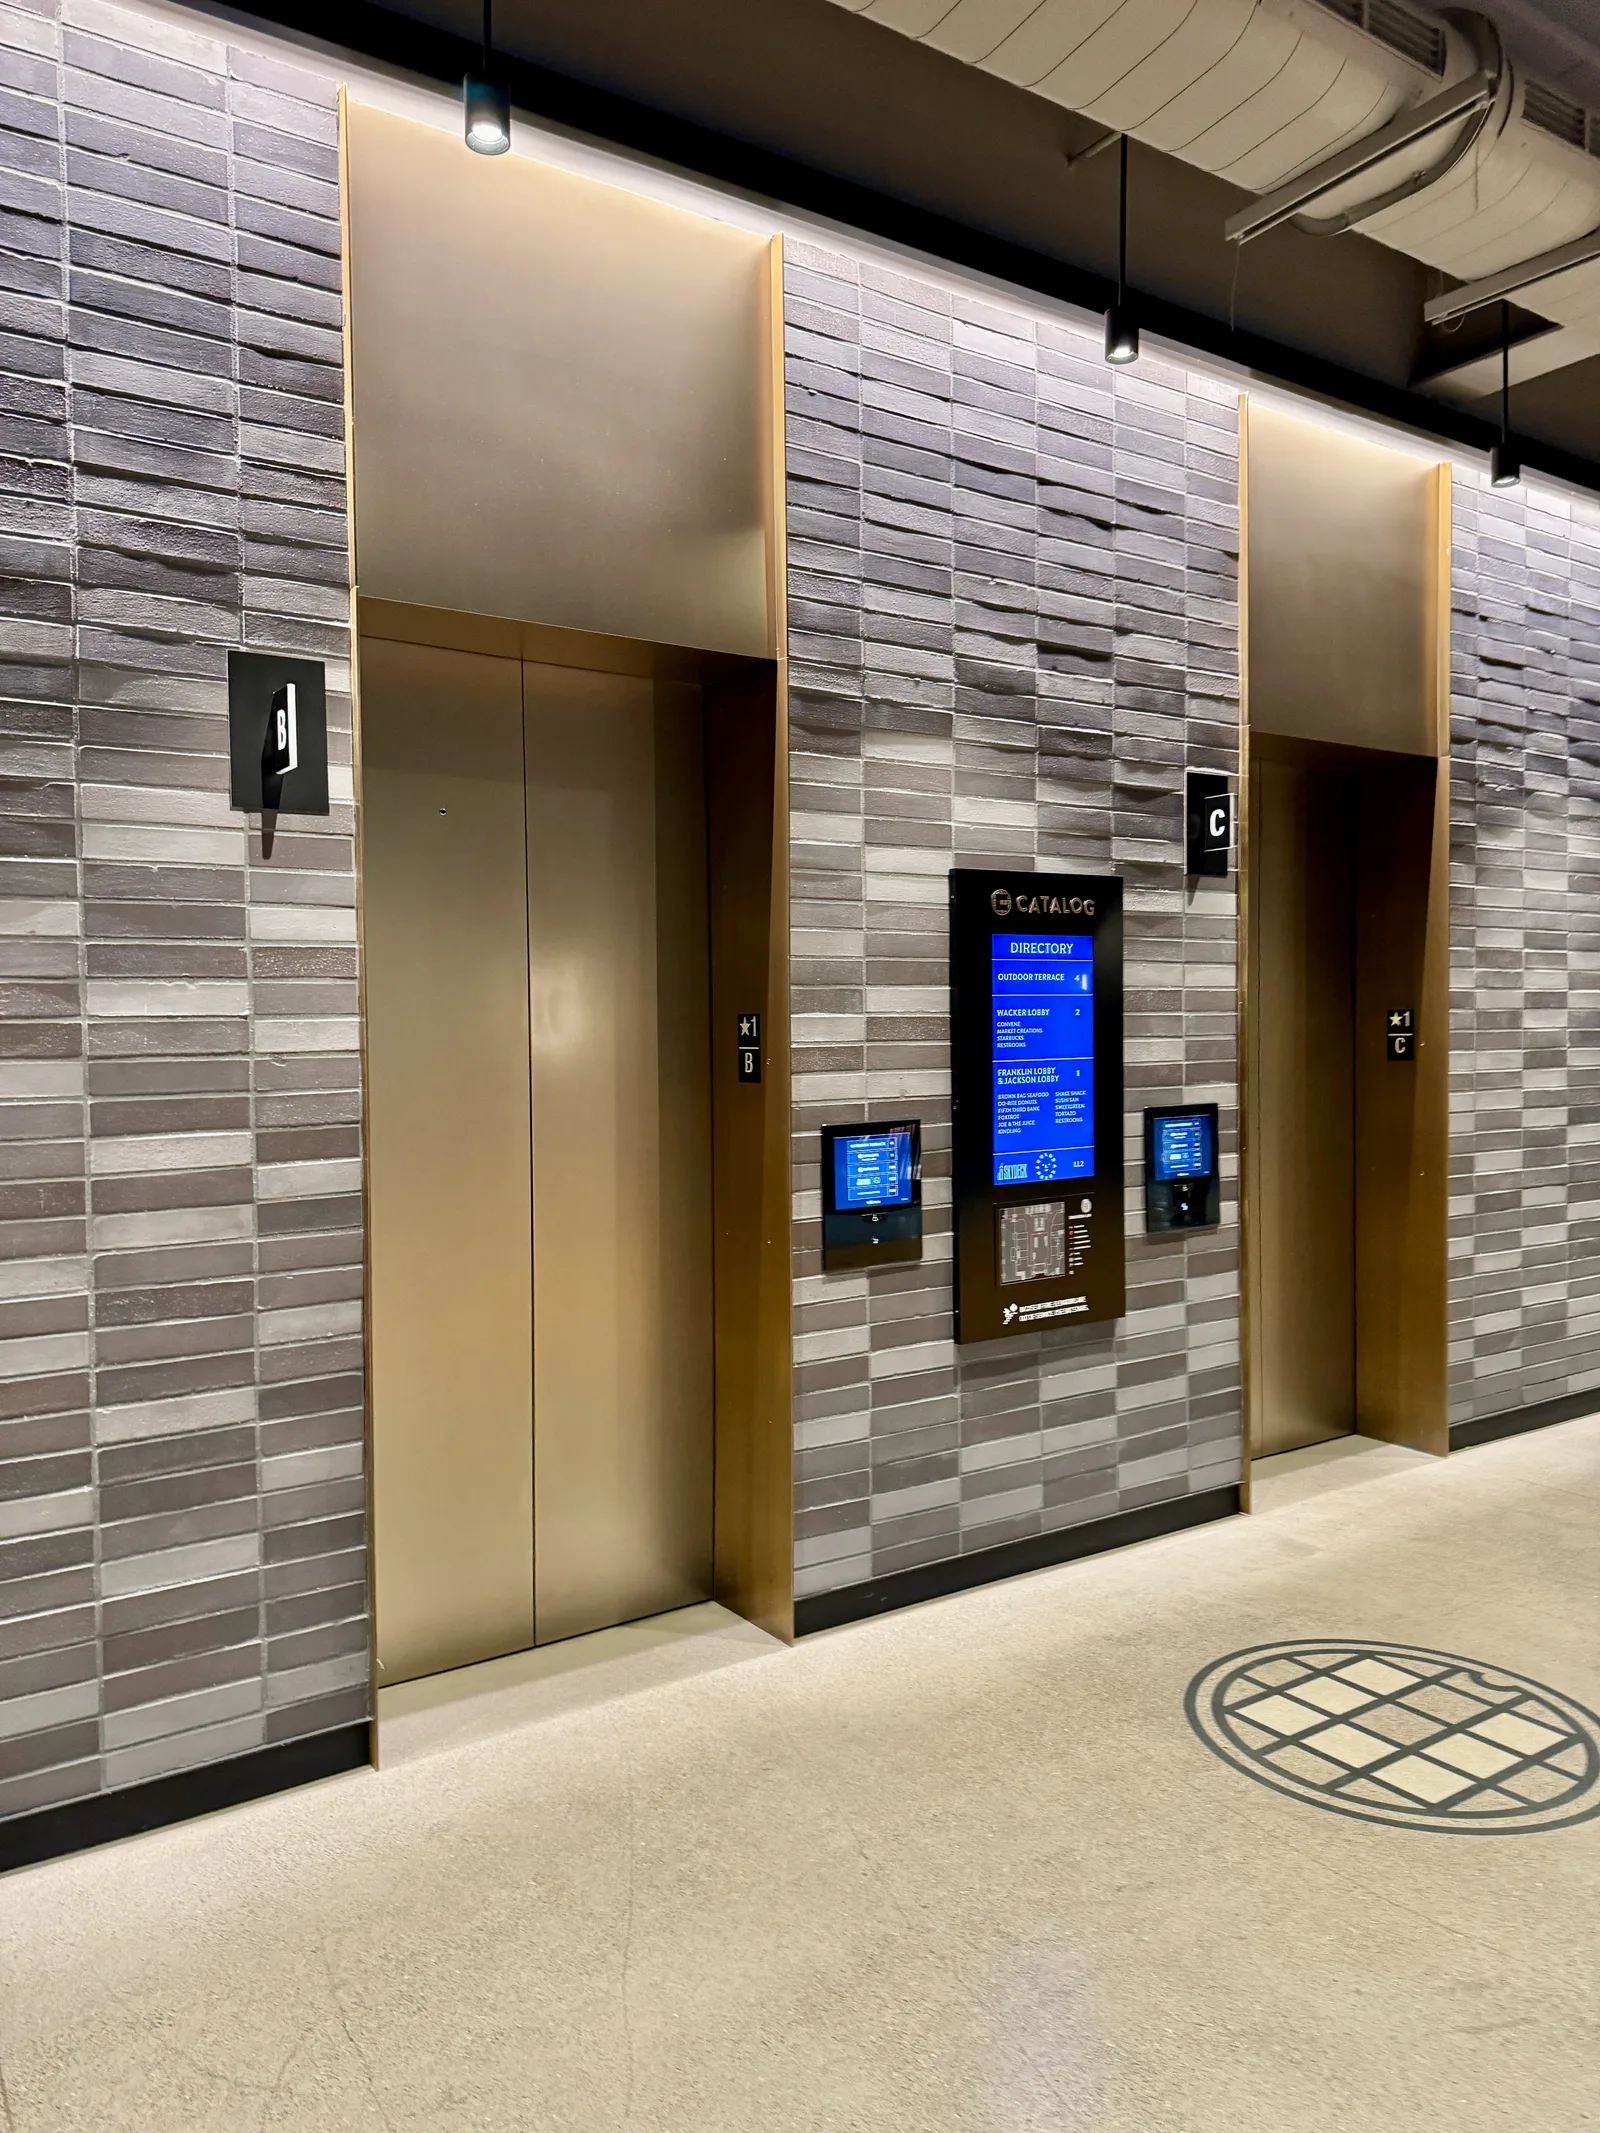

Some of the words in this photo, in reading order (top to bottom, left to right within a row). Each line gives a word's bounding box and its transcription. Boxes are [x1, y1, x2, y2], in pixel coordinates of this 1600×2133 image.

[276, 708, 287, 751] B
[1209, 808, 1226, 837] C
[1016, 895, 1095, 916] CATALOG
[1010, 942, 1074, 954] DIRECTORY
[997, 973, 1033, 981] OUTDOOR
[1034, 973, 1065, 981] TERRACE
[997, 1009, 1027, 1017] WACKER
[1028, 1008, 1050, 1016] LOBBY
[1394, 1037, 1406, 1054] C
[744, 1052, 754, 1073] B
[997, 1068, 1033, 1077] FRANKLIN
[1033, 1067, 1056, 1075] LOBBY
[1004, 1077, 1036, 1085] JACKSON
[1037, 1075, 1060, 1083] LOBBY
